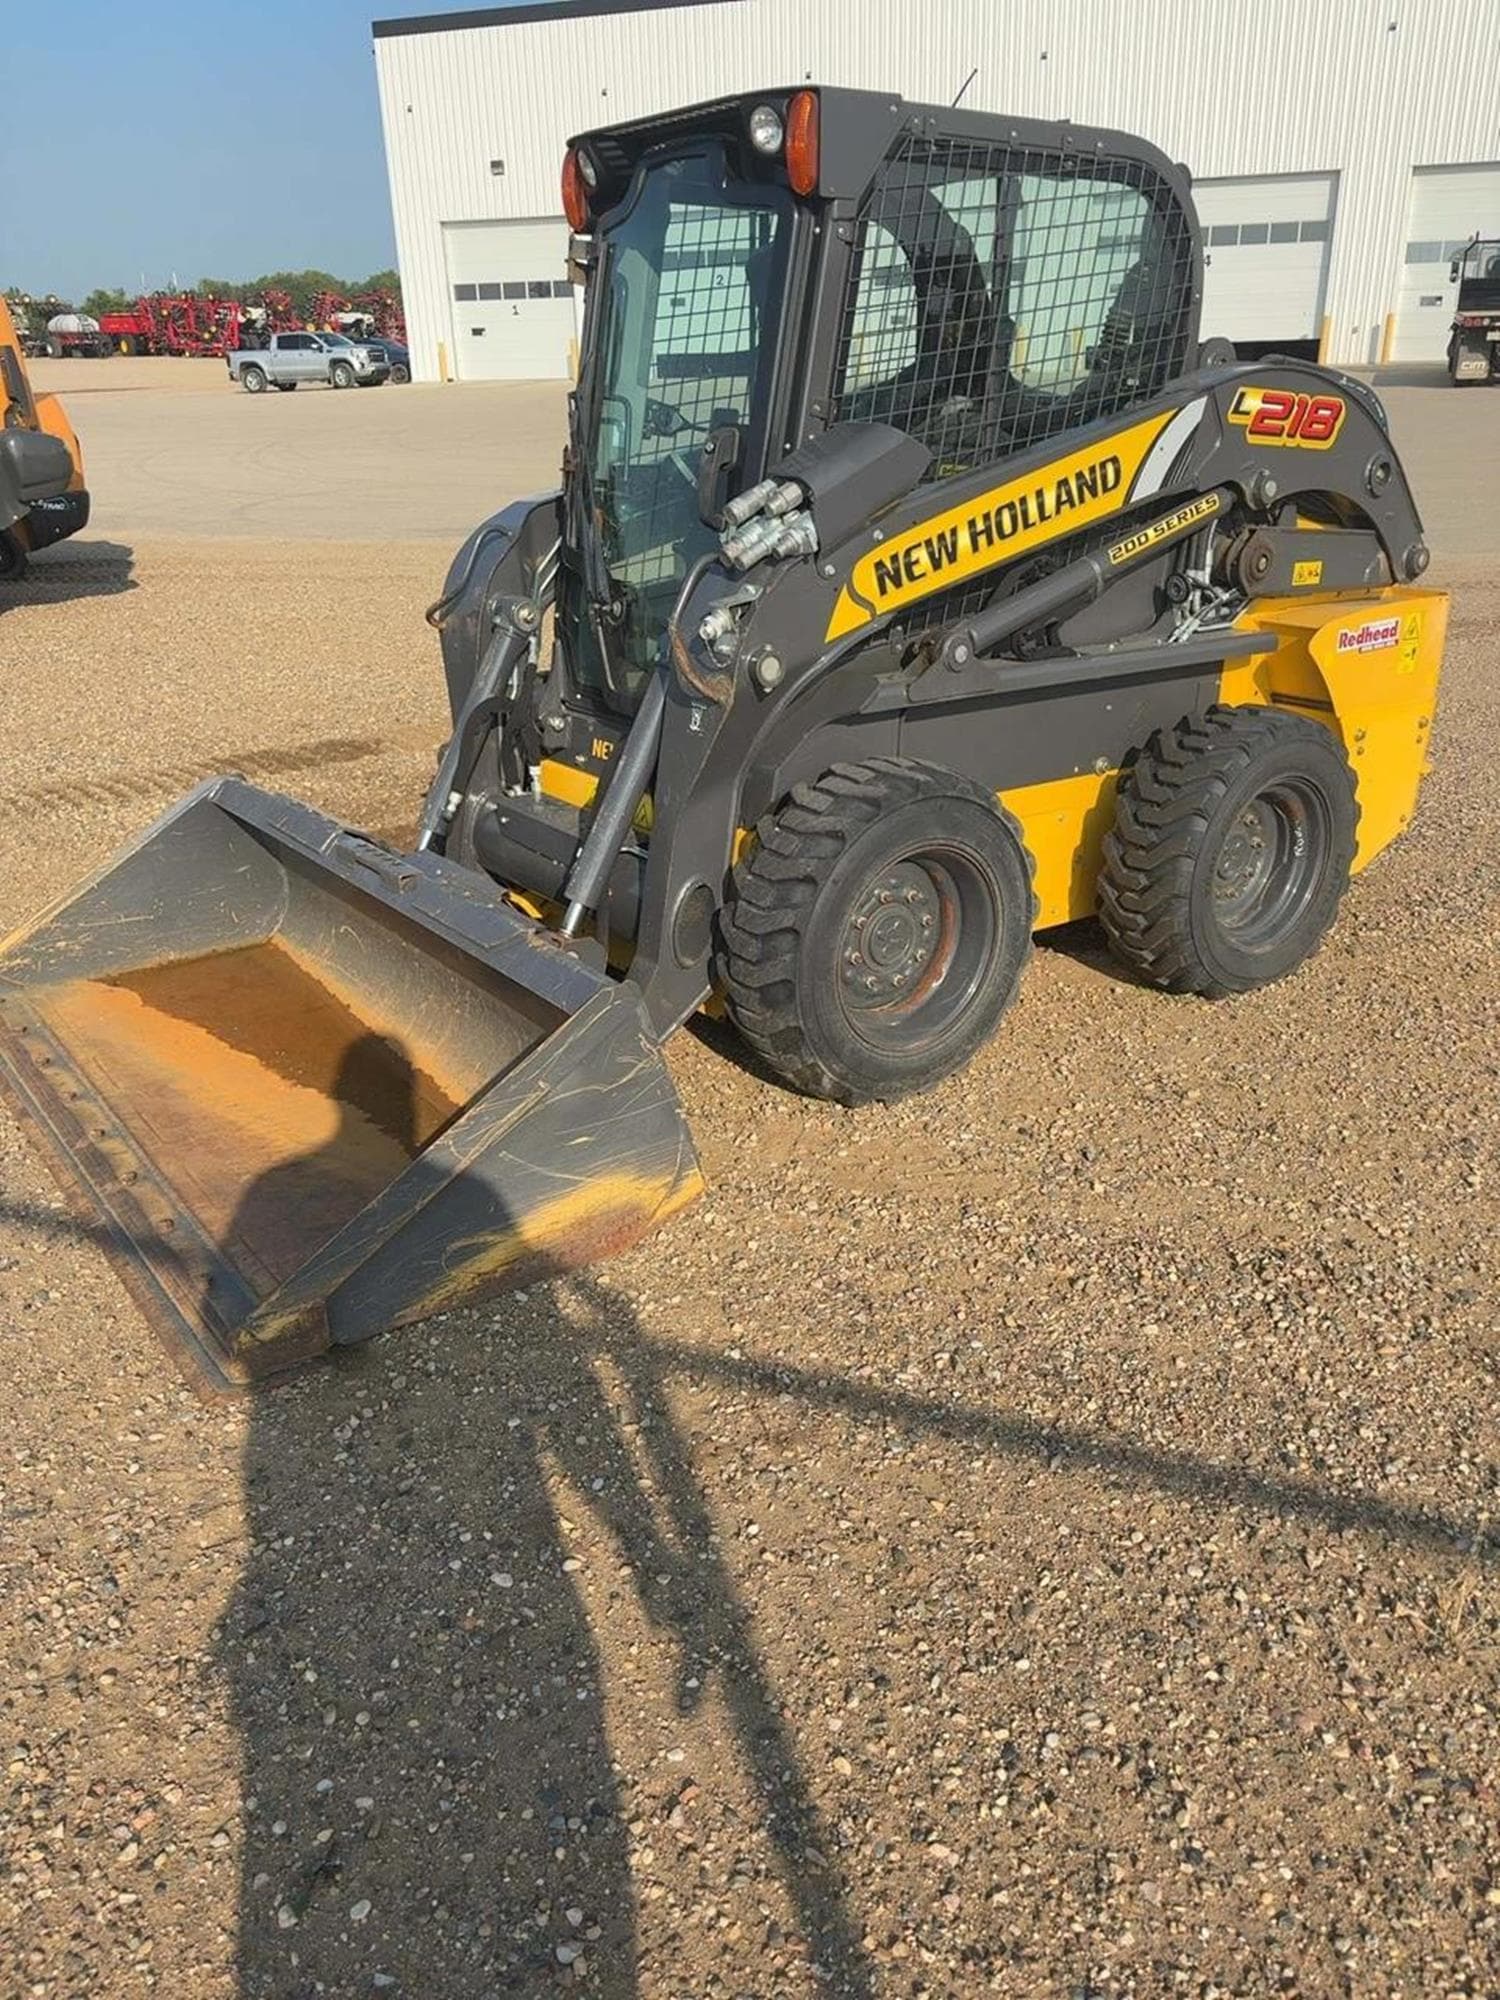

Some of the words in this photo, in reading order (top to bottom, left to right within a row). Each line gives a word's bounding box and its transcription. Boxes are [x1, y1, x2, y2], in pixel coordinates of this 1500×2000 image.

[715, 273, 724, 286] 2
[511, 304, 520, 316] 1
[1230, 389, 1345, 443] L218
[873, 525, 958, 597] NEW
[967, 454, 1122, 554] HOLLAND
[1111, 532, 1150, 561] 200
[1153, 495, 1218, 539] SERIES
[1338, 619, 1400, 649] Redhead
